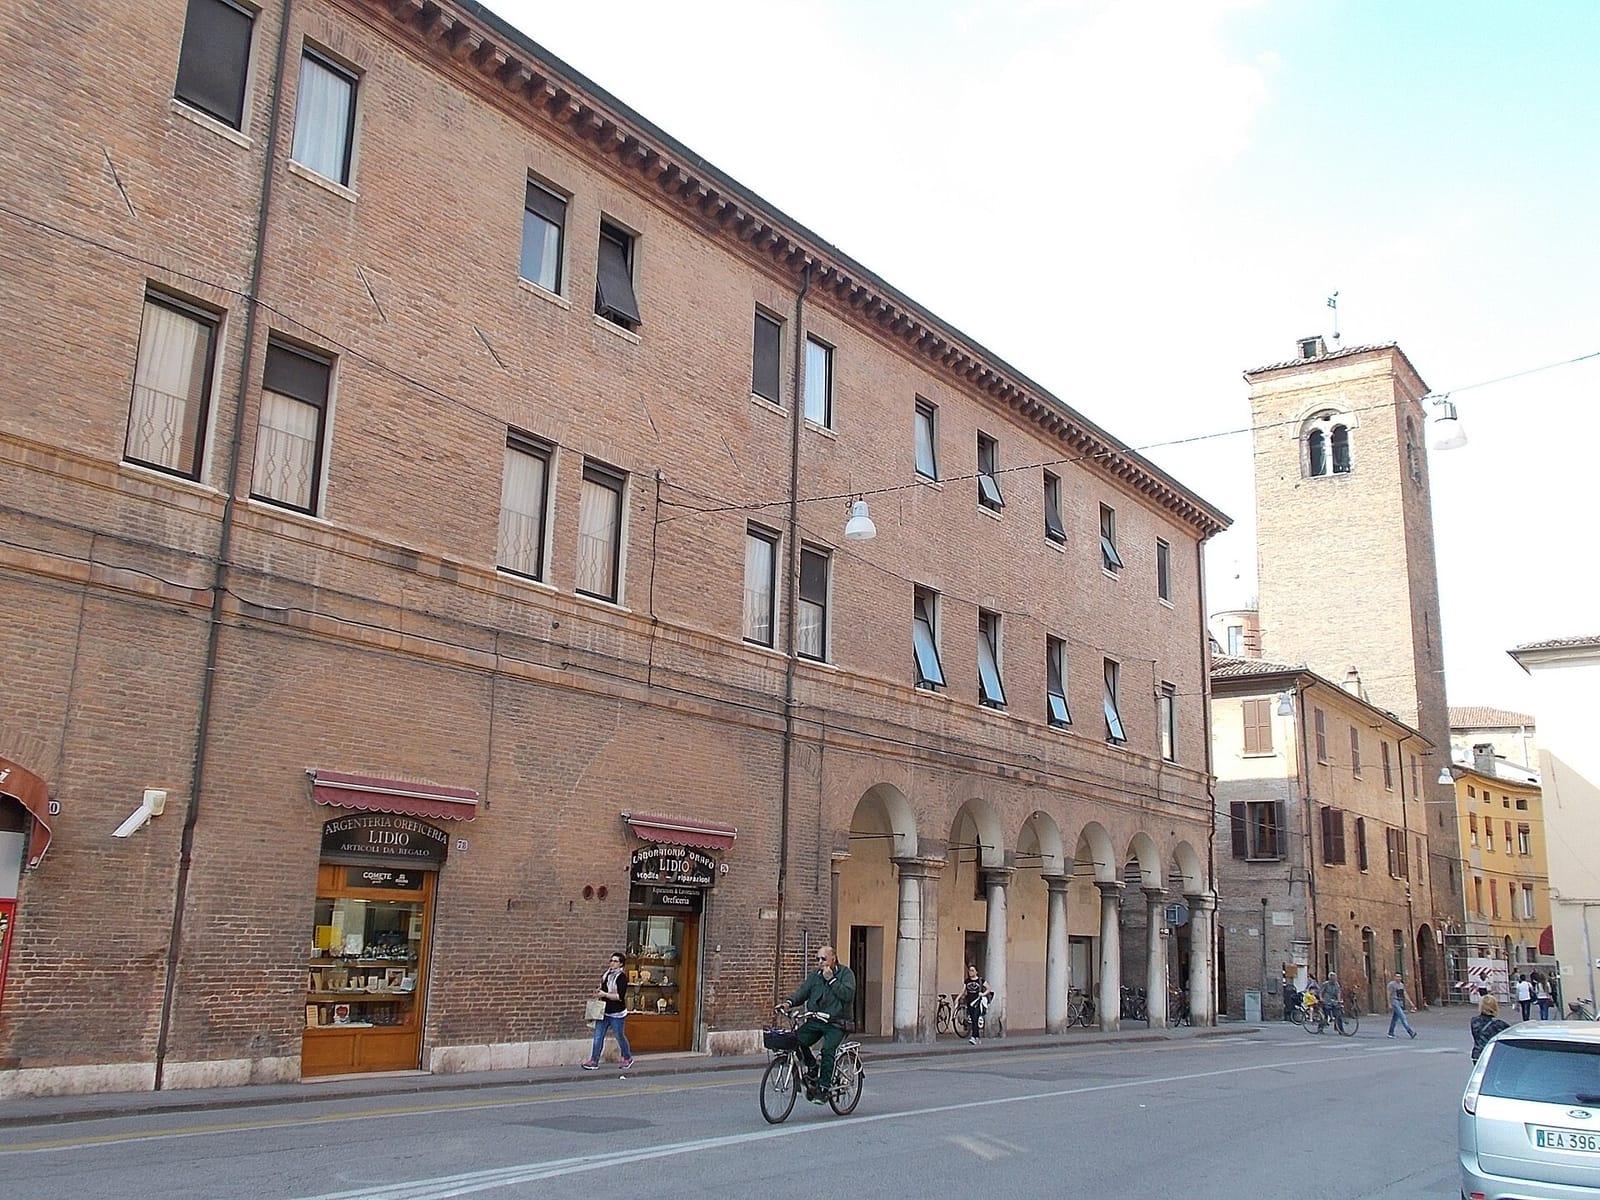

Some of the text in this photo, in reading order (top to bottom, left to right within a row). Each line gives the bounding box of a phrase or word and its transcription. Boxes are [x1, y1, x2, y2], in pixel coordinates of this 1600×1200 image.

[325, 816, 447, 845] ARGENTERIA OREFICERIA
[368, 830, 410, 846] LIDIO
[340, 844, 379, 852] ARTICOLI
[398, 848, 430, 856] REGALO
[632, 847, 686, 864] LABORATORIO
[659, 858, 690, 872] LIDIO
[362, 872, 392, 880] COMETE
[636, 871, 659, 880] vendita
[678, 875, 710, 884] riparazioni
[662, 895, 690, 904] Oreficeria
[1547, 1132, 1600, 1150] EA 396
